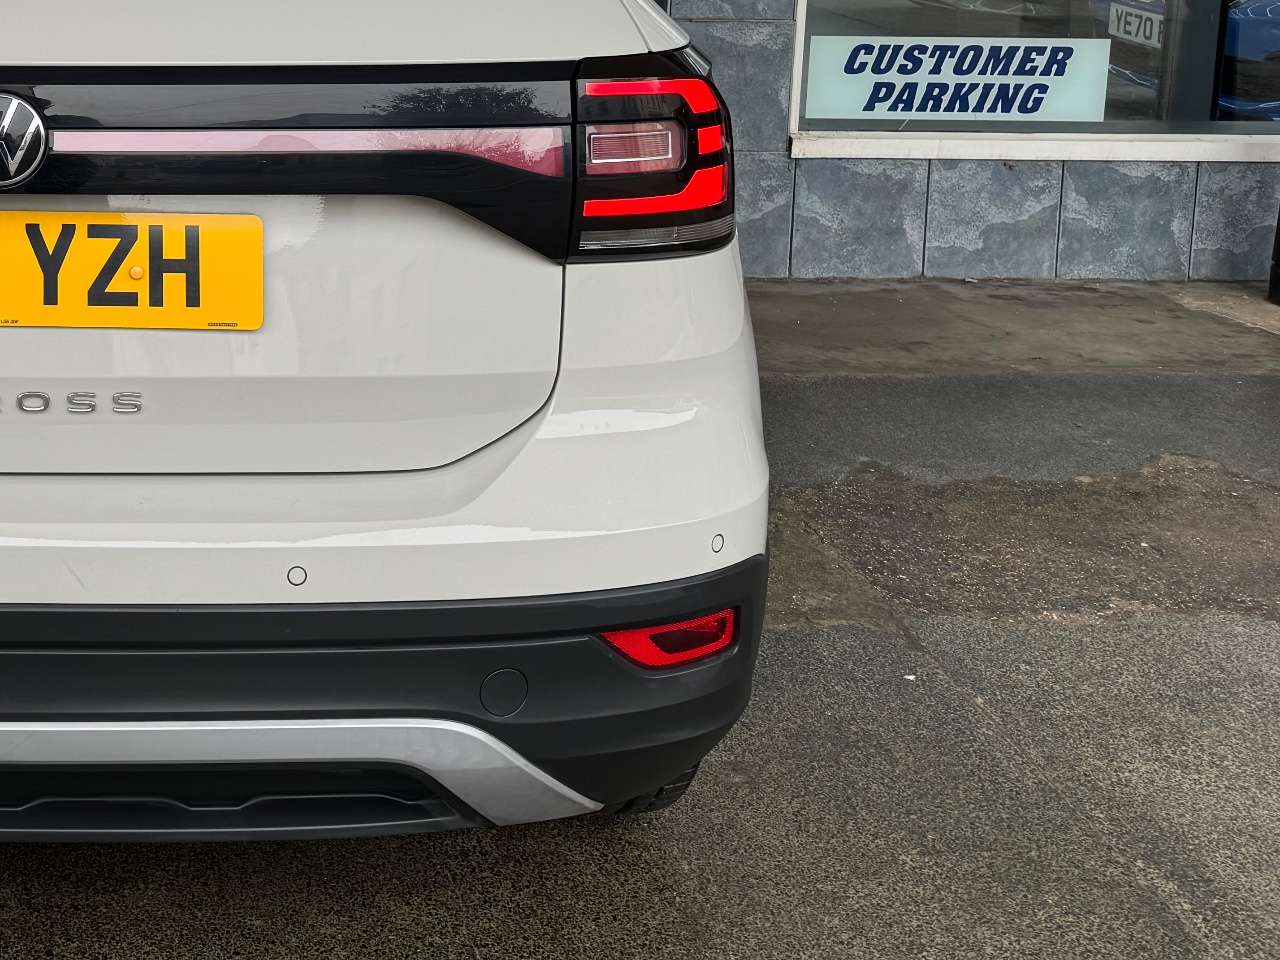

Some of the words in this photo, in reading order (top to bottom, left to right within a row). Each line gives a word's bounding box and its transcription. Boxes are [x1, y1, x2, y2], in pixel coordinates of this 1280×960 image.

[1115, 8, 1154, 41] YE70
[843, 43, 1075, 77] CUSTOMER
[862, 82, 1050, 114] PARKING
[25, 223, 200, 308] YZH
